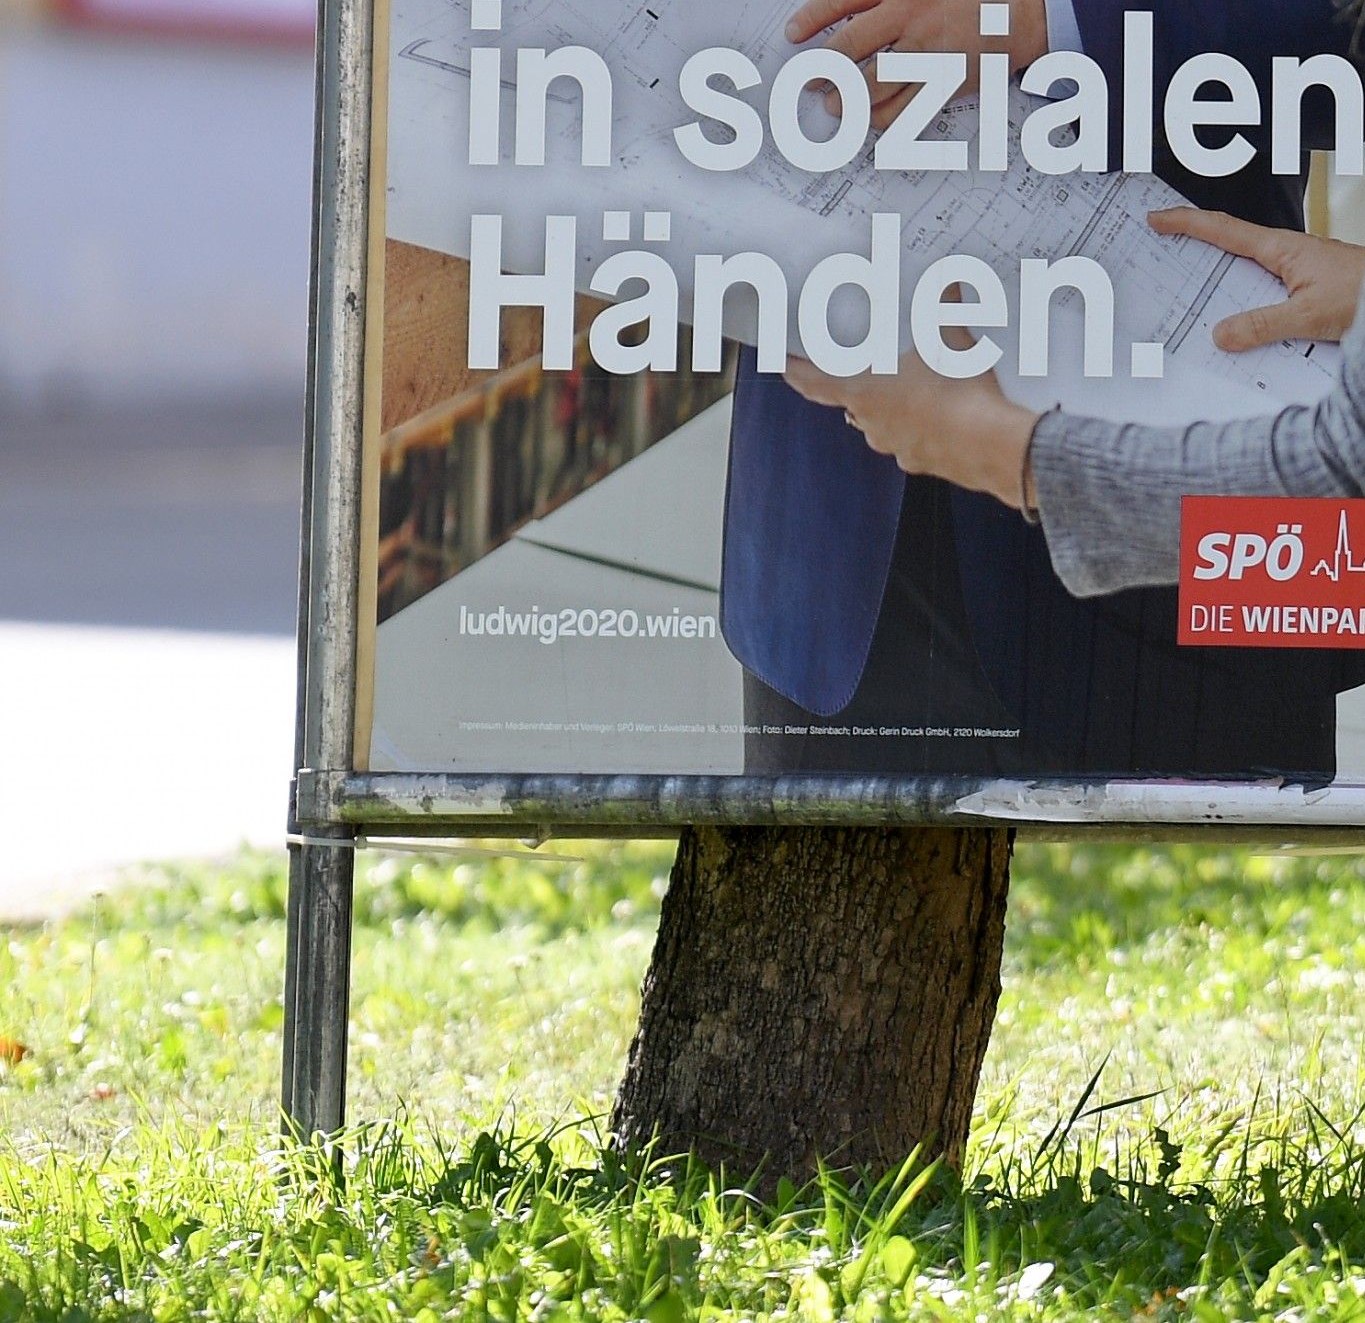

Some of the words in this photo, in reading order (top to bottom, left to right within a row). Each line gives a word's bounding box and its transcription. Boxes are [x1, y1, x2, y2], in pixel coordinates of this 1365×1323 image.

[674, 3, 1365, 177] sozialen
[468, 211, 1165, 380] Händen.
[1193, 524, 1304, 581] SPÖ
[459, 606, 716, 645] ludwig2020.wien
[1191, 605, 1234, 632] DIE
[762, 725, 783, 735] Foto:
[784, 726, 808, 735] Dieter
[852, 727, 878, 736] Druck:
[901, 727, 924, 737] Druck
[953, 728, 973, 738] 2120
